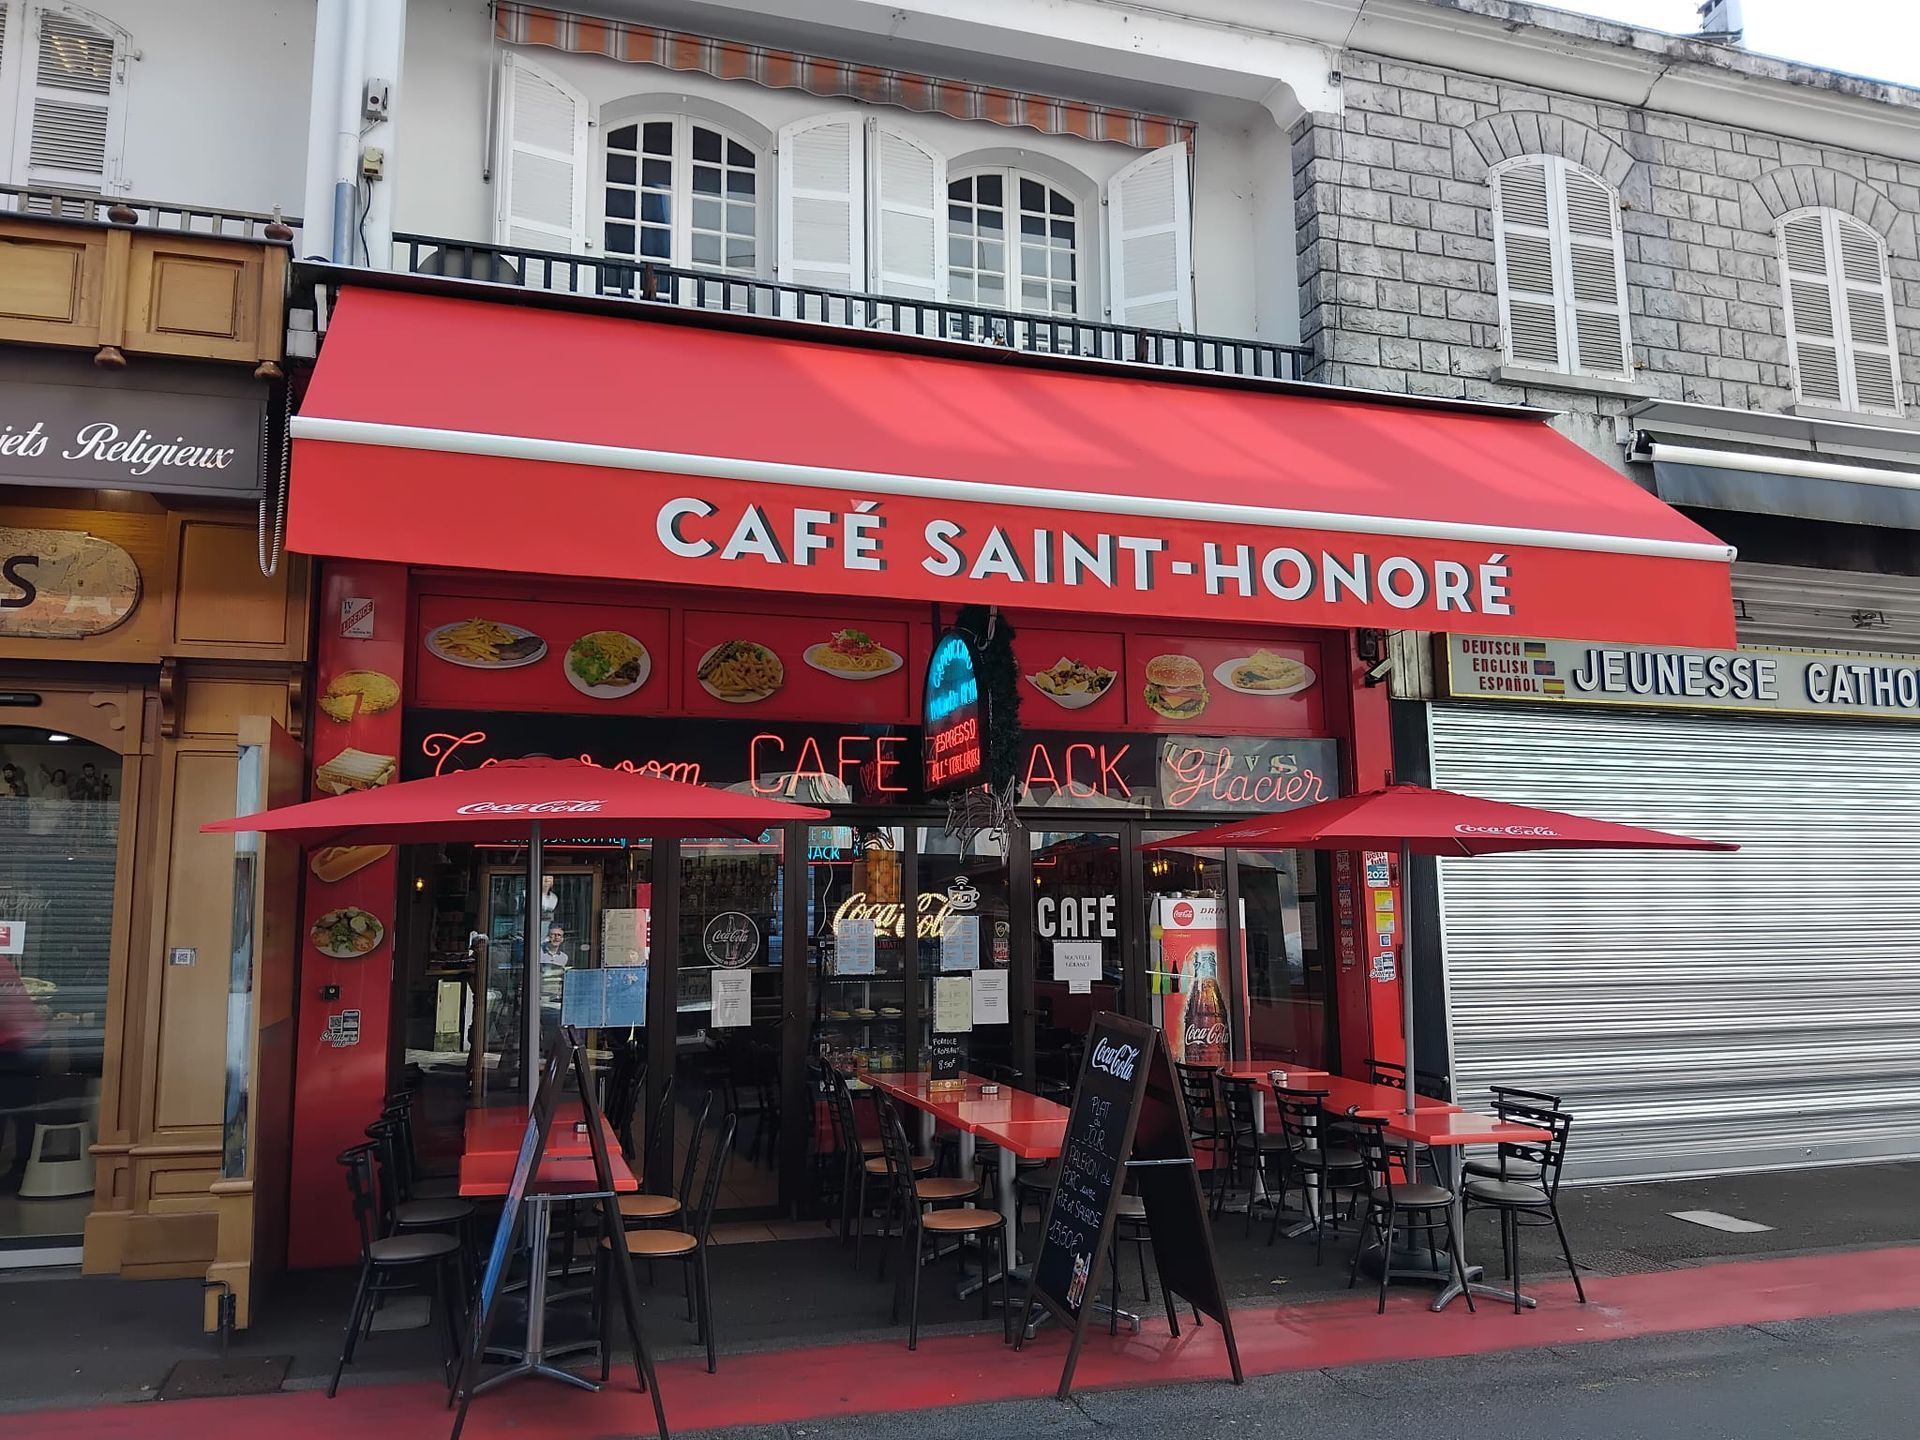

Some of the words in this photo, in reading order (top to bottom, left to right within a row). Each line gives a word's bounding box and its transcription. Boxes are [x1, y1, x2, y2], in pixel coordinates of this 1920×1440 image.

[63, 422, 235, 476] Religieux
[656, 497, 887, 571] CAFÉ
[921, 518, 1515, 616] SAINT-HONORÉ
[1462, 639, 1520, 656] DEUTSCH
[1473, 657, 1529, 675] ENGLISH
[1573, 648, 1779, 700] JEUNESSE
[1479, 674, 1539, 693] ESPAÑOL
[936, 718, 976, 753] ESPRESSO
[751, 734, 908, 793] CAFE
[1023, 742, 1132, 799] ACK
[1167, 747, 1329, 807] Glacier
[456, 800, 608, 815] Coca-Cola
[1454, 823, 1561, 837] Coca-Cola
[1368, 870, 1389, 880] 2022
[1037, 894, 1117, 938] CAFÉ
[1200, 907, 1226, 915] DRIN
[1185, 1022, 1230, 1046] Coca-Cola
[1092, 1037, 1140, 1081] Coca-Cola
[1092, 1096, 1112, 1120] PLAT
[1084, 1124, 1106, 1151] JOUR
[1062, 1165, 1080, 1191] PORC
